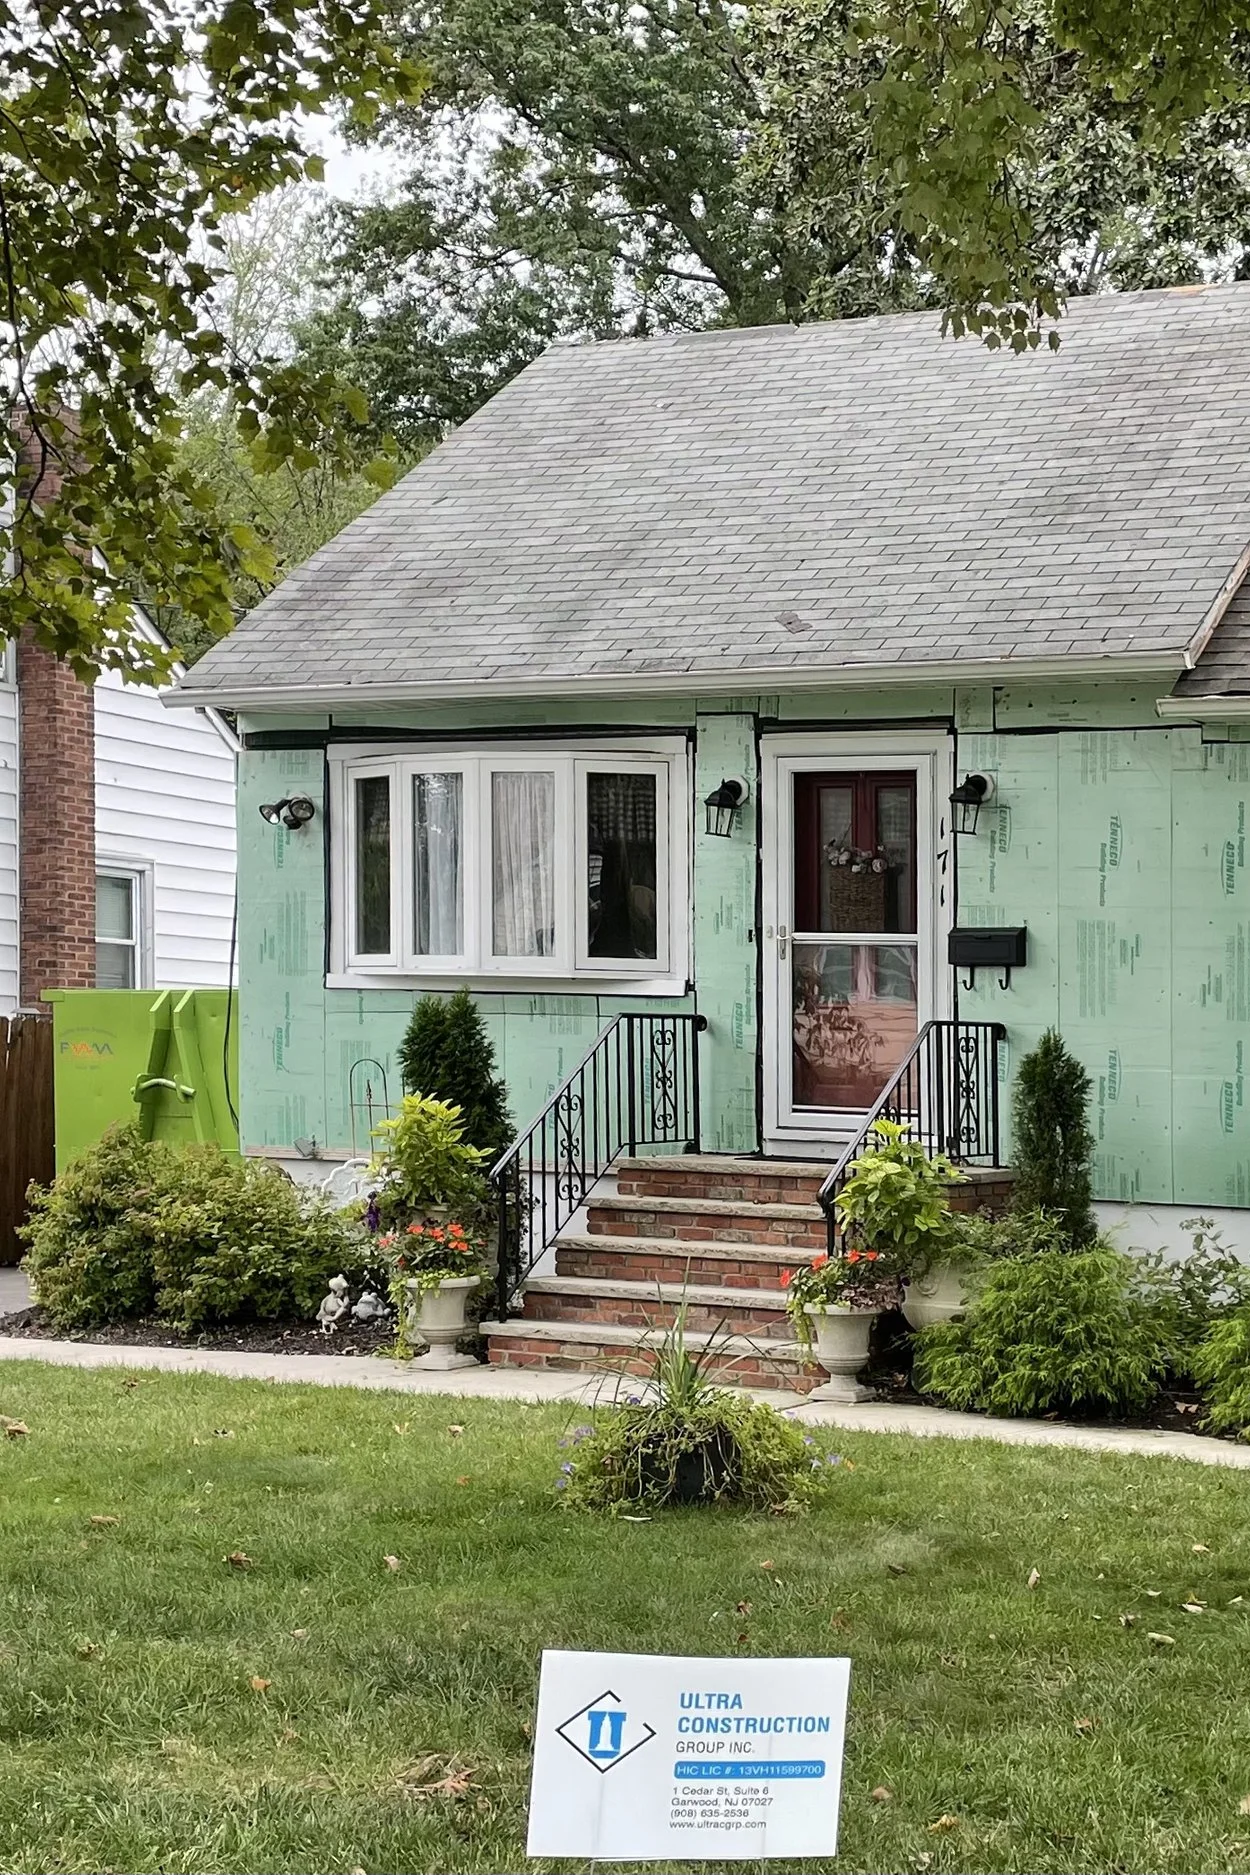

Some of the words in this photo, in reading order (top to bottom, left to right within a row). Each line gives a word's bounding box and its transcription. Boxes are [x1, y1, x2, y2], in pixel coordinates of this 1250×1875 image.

[1109, 815, 1119, 867] TENNECO
[1226, 842, 1235, 895] TENNECO
[735, 1002, 744, 1050] TENNECO
[1107, 1049, 1117, 1100] TENNECO
[1223, 1082, 1234, 1134] TENNECO
[680, 1692, 743, 1710] ULTRA
[678, 1716, 831, 1734] CONSTRUCTION
[675, 1741, 725, 1754] GROUP
[729, 1741, 756, 1754] INC.
[676, 1765, 699, 1776] HIC
[702, 1765, 721, 1776] LIC
[673, 1787, 678, 1795] 1
[682, 1786, 714, 1796] Cedar
[716, 1786, 730, 1797] St,
[733, 1786, 760, 1795] Suite
[671, 1797, 721, 1808] Garwood,
[724, 1798, 739, 1807] NJ
[741, 1797, 774, 1807] 07027
[670, 1808, 698, 1819] (908)
[669, 1819, 767, 1831] www.ultracgrp.com
